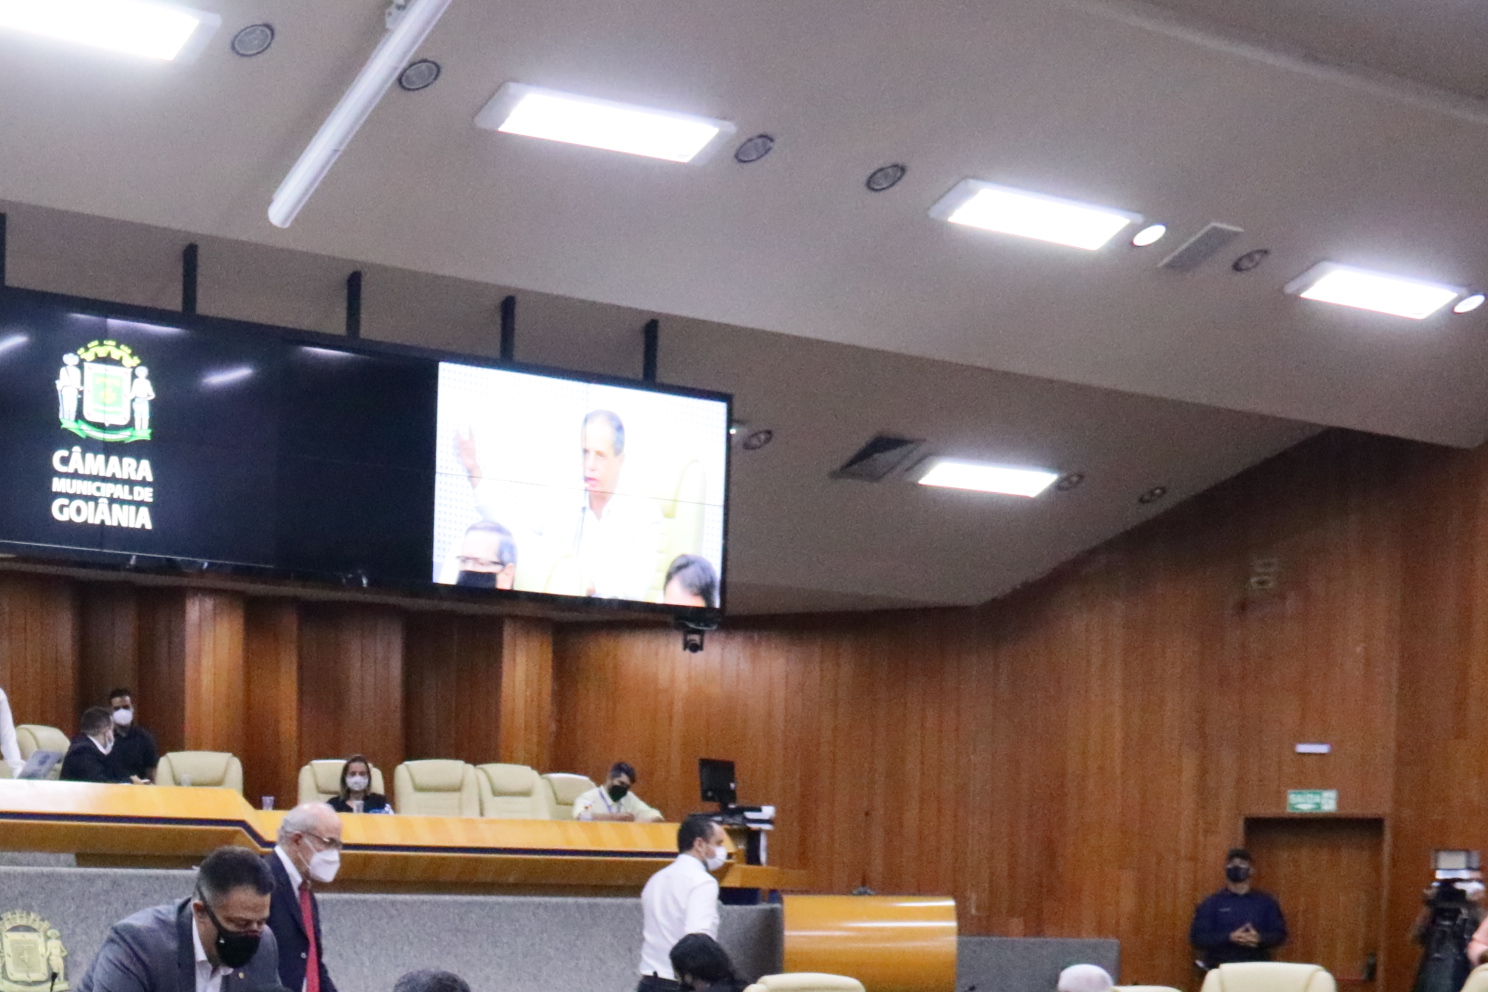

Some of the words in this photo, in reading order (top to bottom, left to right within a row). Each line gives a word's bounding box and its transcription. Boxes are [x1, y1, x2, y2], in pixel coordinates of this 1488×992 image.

[52, 445, 154, 482] CÂMARA
[52, 477, 132, 500] MUNICIPAL
[133, 486, 154, 502] DE
[51, 498, 152, 529] GOIÂNIA
